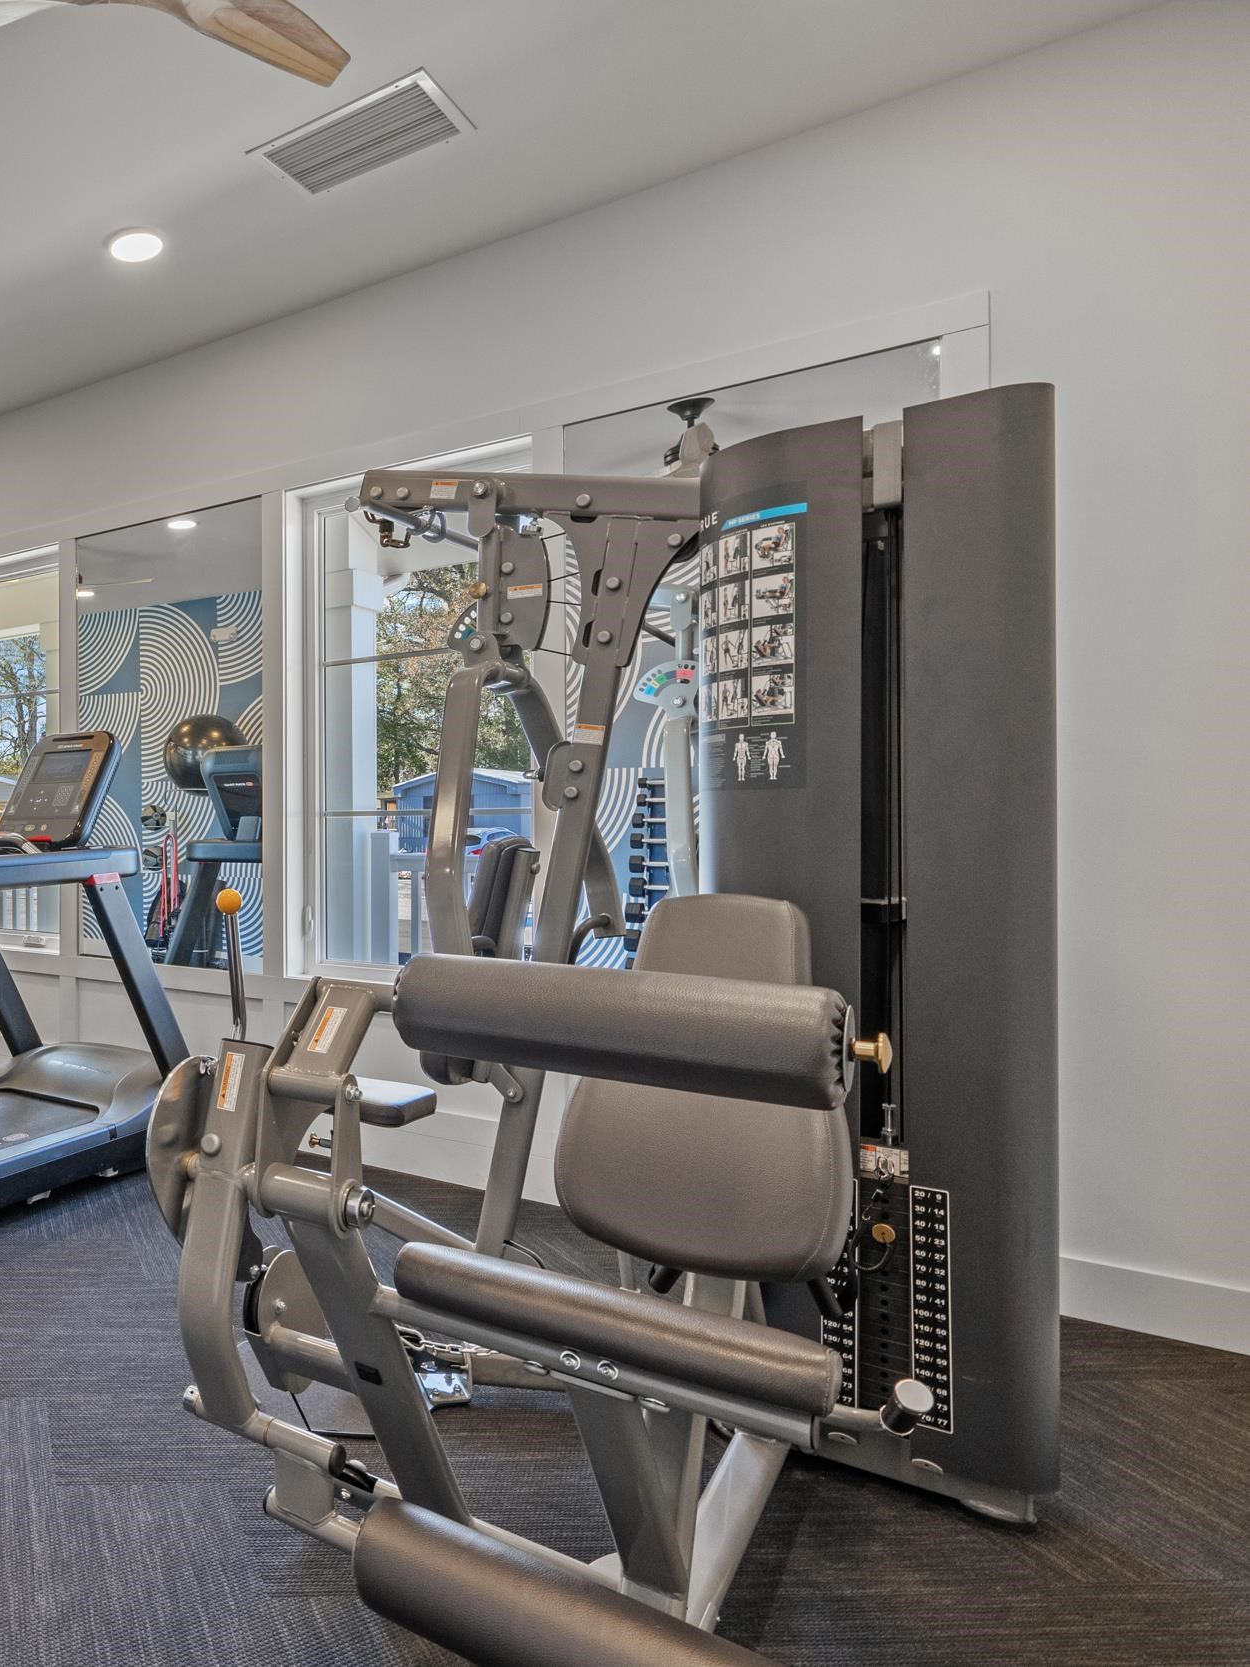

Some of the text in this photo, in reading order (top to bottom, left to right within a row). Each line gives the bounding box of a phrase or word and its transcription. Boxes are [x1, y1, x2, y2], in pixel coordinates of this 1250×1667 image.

[700, 511, 718, 532] RUE
[914, 1190, 926, 1198] 20
[914, 1204, 926, 1212] 30
[914, 1220, 926, 1228] 40
[934, 1282, 946, 1290] 36
[936, 1402, 948, 1410] 73
[936, 1418, 948, 1426] 77
